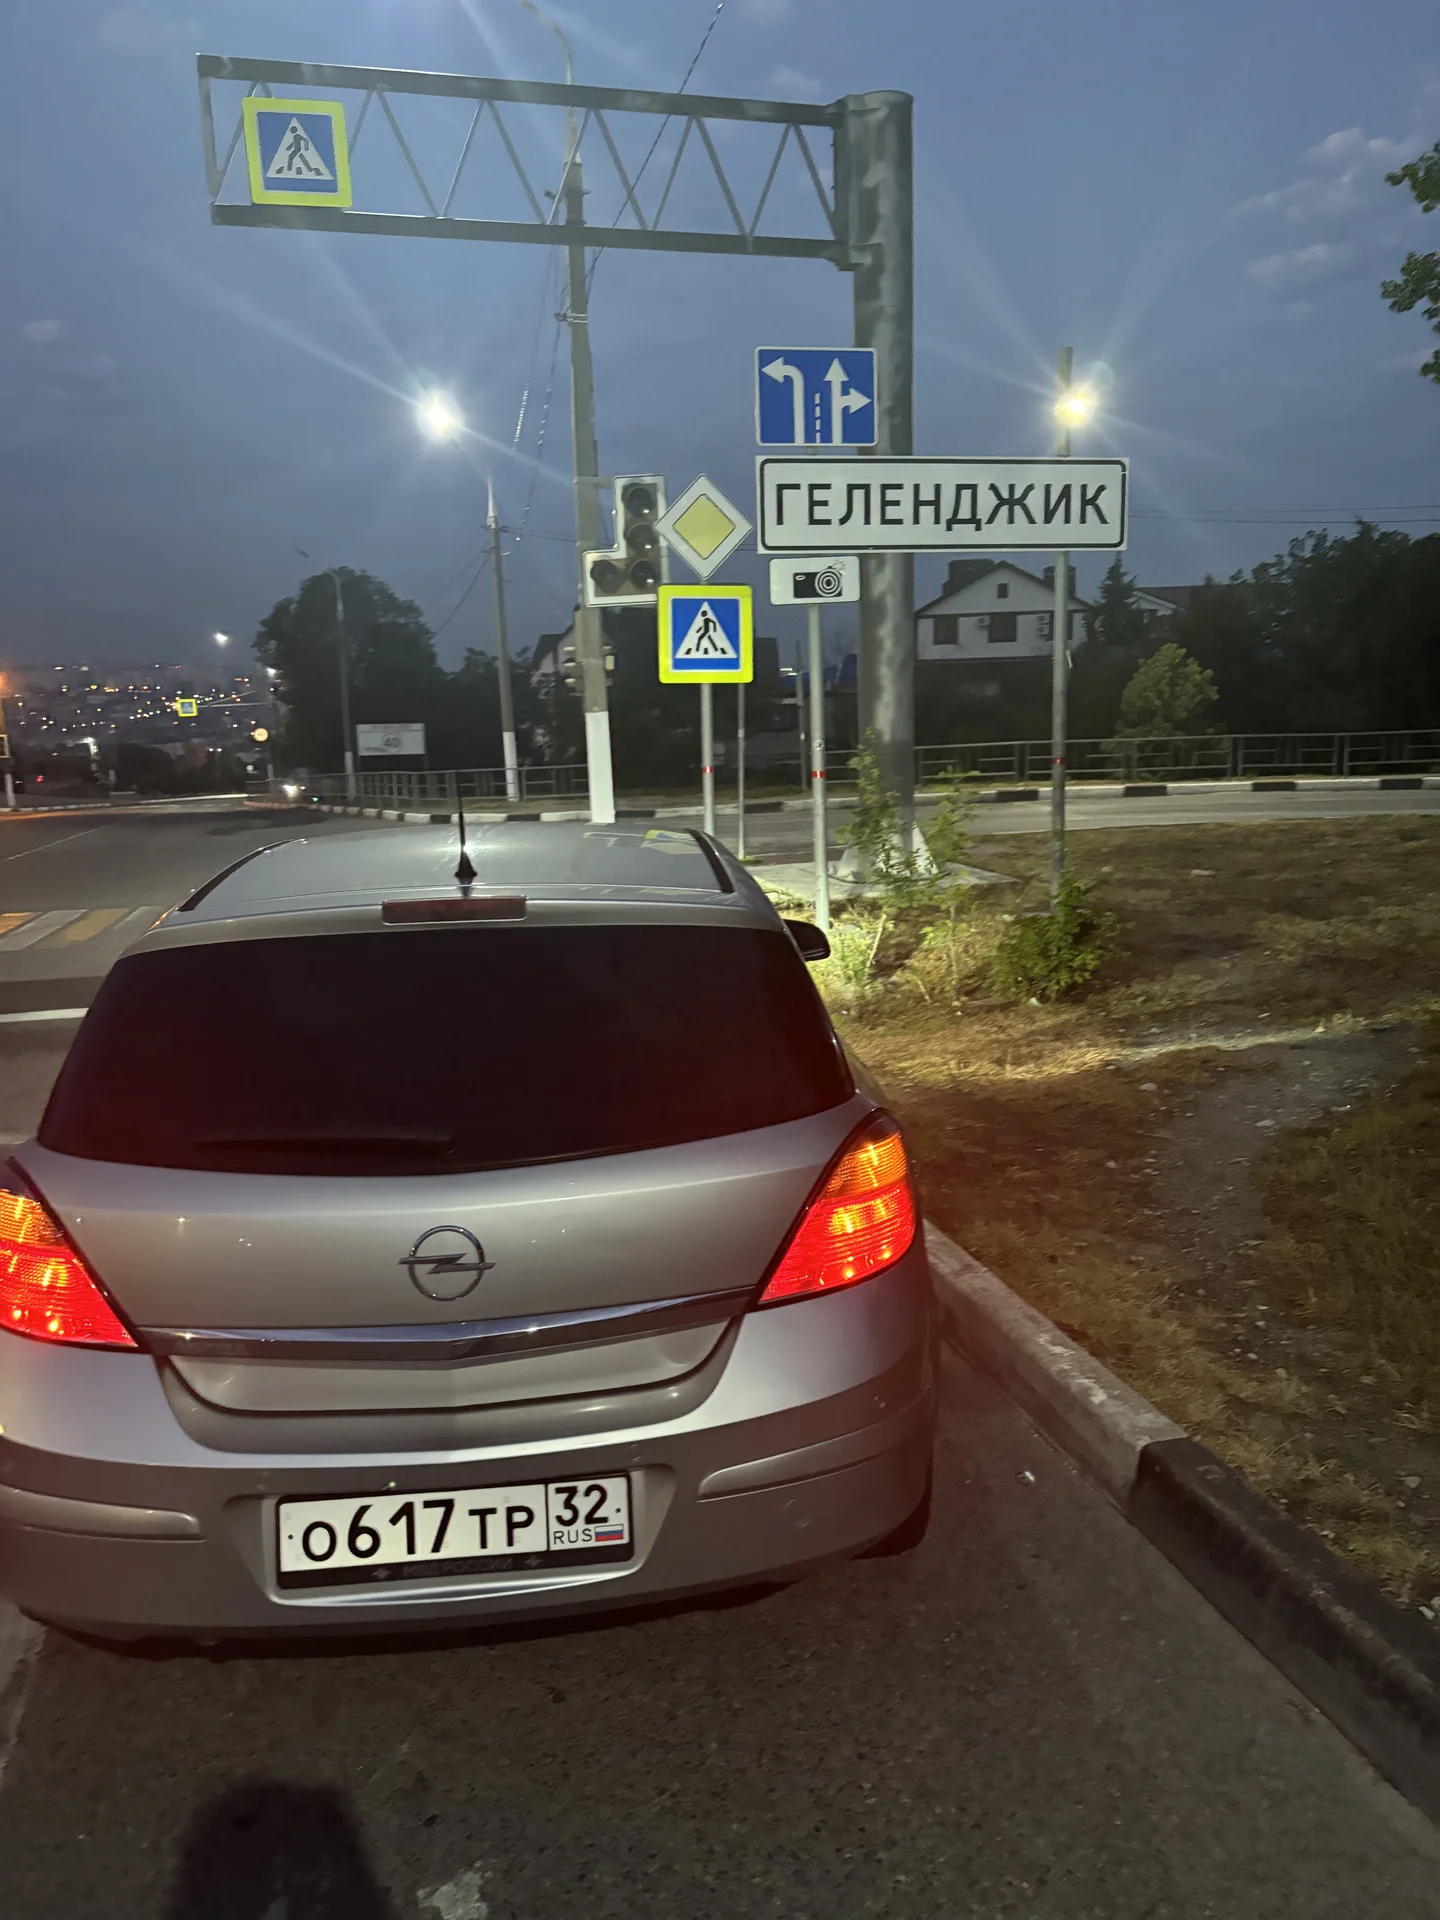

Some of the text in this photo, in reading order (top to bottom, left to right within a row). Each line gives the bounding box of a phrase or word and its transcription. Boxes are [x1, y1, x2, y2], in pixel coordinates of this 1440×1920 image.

[775, 483, 1110, 532] ГЕЛЕНДЖИК
[302, 1484, 609, 1562] О617ТР 32
[552, 1527, 594, 1545] RUS
